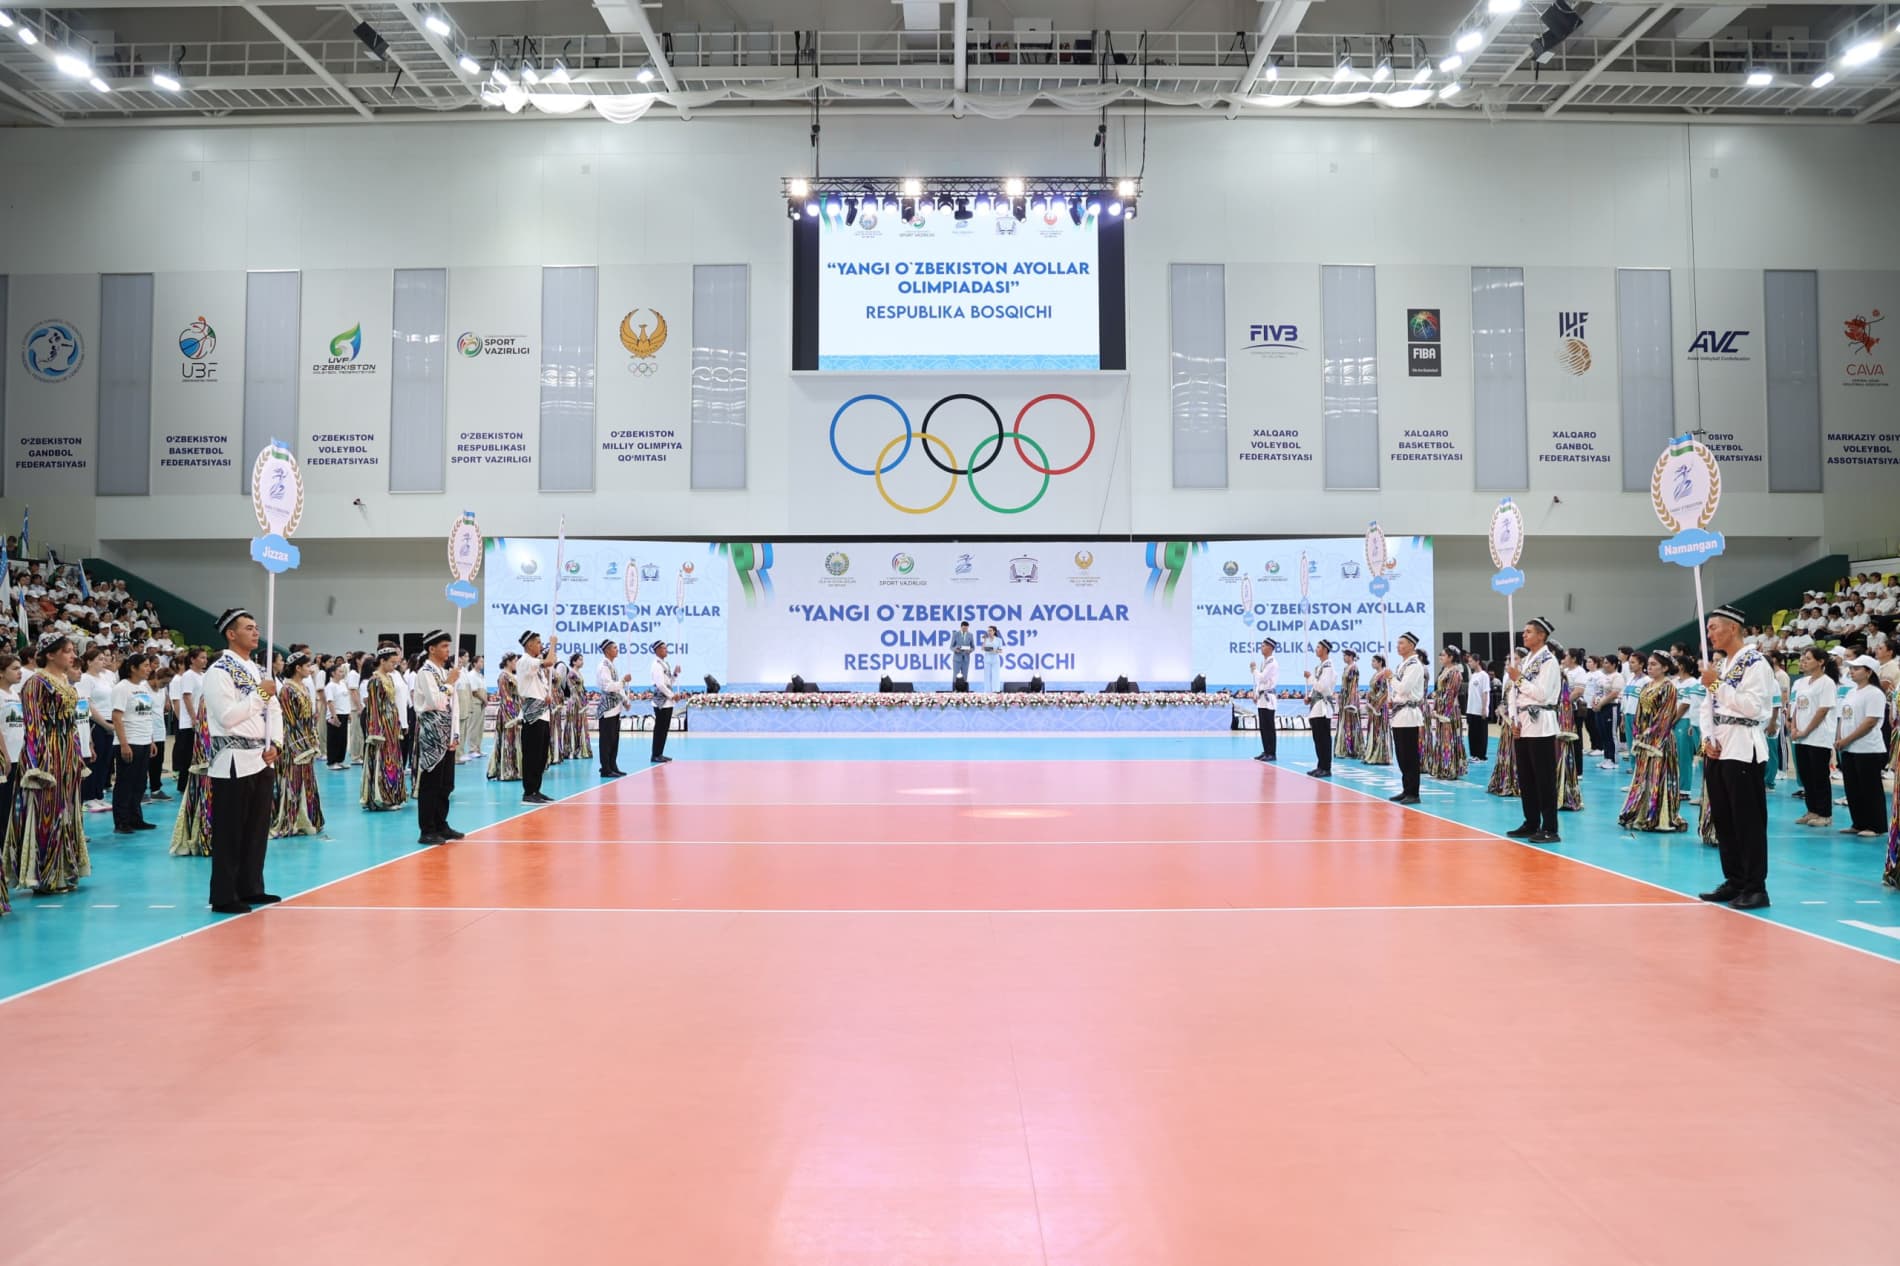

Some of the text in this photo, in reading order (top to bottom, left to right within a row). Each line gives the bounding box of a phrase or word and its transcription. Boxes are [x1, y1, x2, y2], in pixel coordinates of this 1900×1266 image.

[827, 262, 889, 275] “YANGI
[1013, 262, 1090, 275] AYOLLAR
[897, 280, 1020, 294] OLIMPIADASI”
[866, 305, 1052, 319] RESPUBLIKA BOSQICHI
[1250, 325, 1298, 342] FIVB
[484, 338, 515, 346] SPORT
[1688, 331, 1750, 353] AVC
[484, 347, 530, 355] VAZIRLIGI
[1413, 348, 1436, 359] FIBA
[1846, 363, 1884, 376] CAVA
[1253, 429, 1299, 438] XALQARO
[1404, 429, 1449, 438] XALQARO
[1552, 430, 1597, 440] XALQARO
[1708, 433, 1734, 441] OSIYO
[1827, 433, 1900, 441] MARKAZIY OSIY
[318, 445, 368, 454] VOLEYBOL
[457, 443, 527, 452] RESPUBLIKASI
[602, 441, 684, 451] MILLIY OLIMPIYA
[1251, 441, 1302, 450] VOLEYBOL
[1398, 441, 1455, 450] BASKETBOL
[1555, 442, 1594, 451] GANBOL
[1843, 445, 1892, 453] VOLEYBOL
[28, 449, 74, 458] GANDBOL
[168, 446, 225, 456] BASKETBOL
[307, 457, 379, 465] FEDERATSIYASI
[450, 455, 532, 464] SPORT VAZIRLIGI
[1239, 452, 1313, 461] FEDERATSIYASI
[1391, 452, 1463, 461] FEDERATSIYASI
[1539, 454, 1611, 463] FEDERATSIYASI
[1715, 454, 1762, 462] ERATSIYASI
[15, 460, 87, 470] FEDERATSIYASI
[160, 458, 232, 467] FEDERATSIYASI
[1664, 540, 1718, 556] Namangan
[492, 603, 548, 616] “YANGI
[789, 604, 869, 622] “YANGI
[1030, 604, 1130, 622] AYOLLAR
[1197, 603, 1244, 616] “YANG
[555, 621, 662, 633] OLIMPIADASI”
[1229, 641, 1392, 654] RESPBLIKA OSQICHI
[844, 653, 1075, 671] RESPUBLIK BSQICHI
